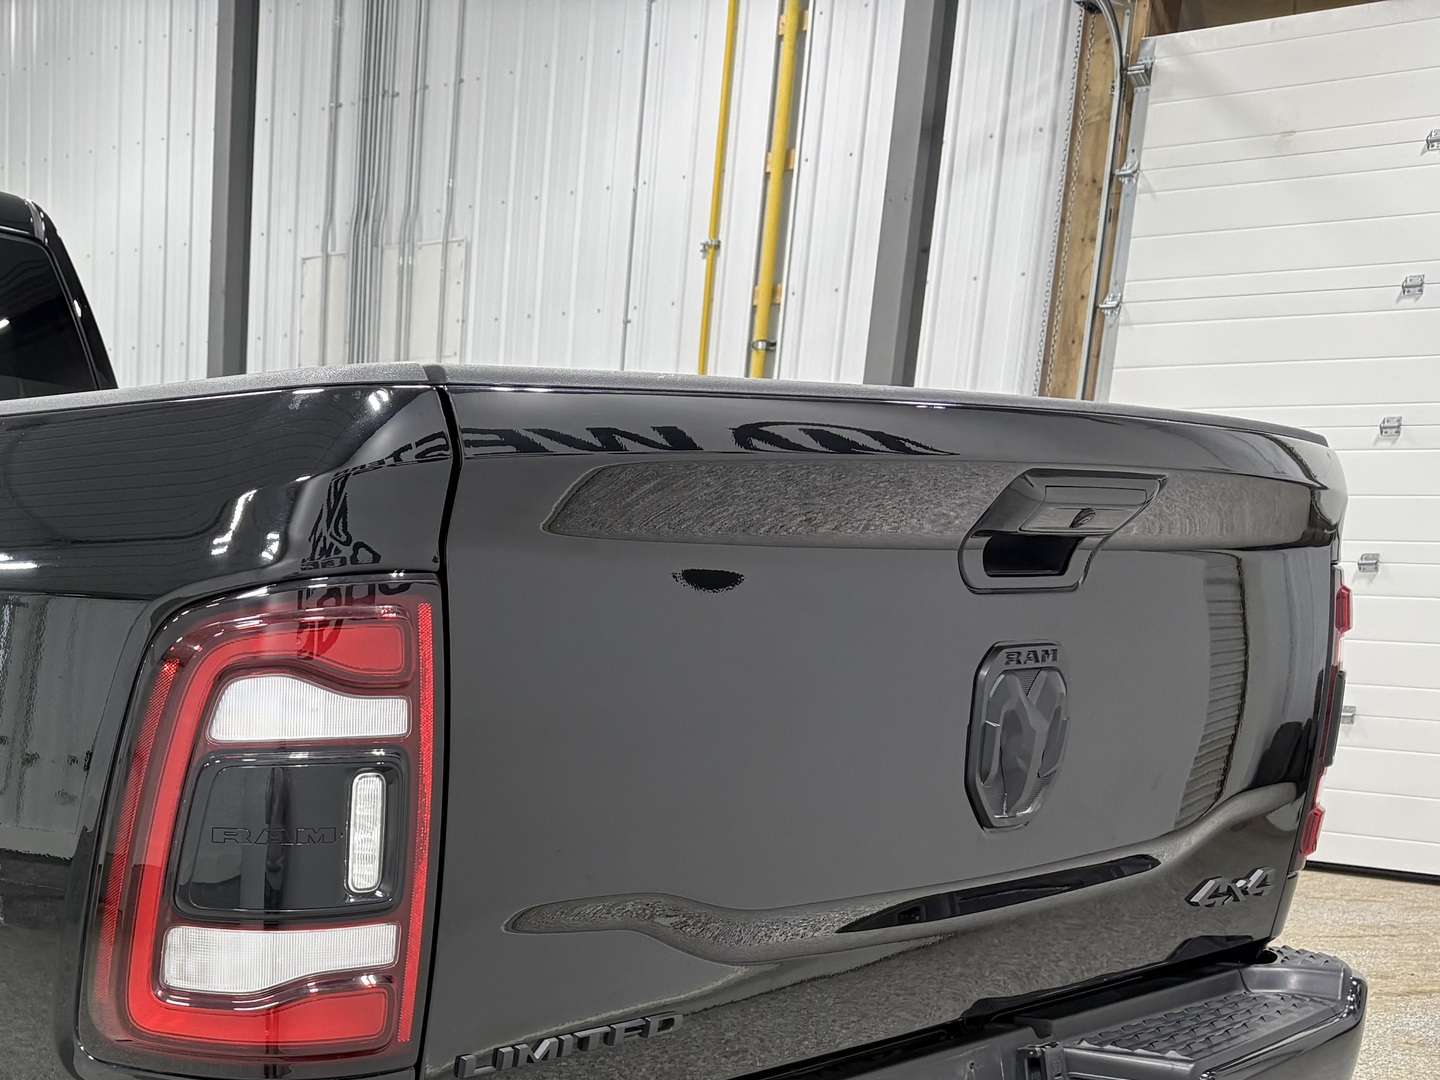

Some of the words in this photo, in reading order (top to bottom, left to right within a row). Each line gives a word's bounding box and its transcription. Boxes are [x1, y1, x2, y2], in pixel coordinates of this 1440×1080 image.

[1004, 648, 1059, 666] RAM
[211, 826, 337, 846] RAM
[454, 1011, 683, 1078] LIMITED
